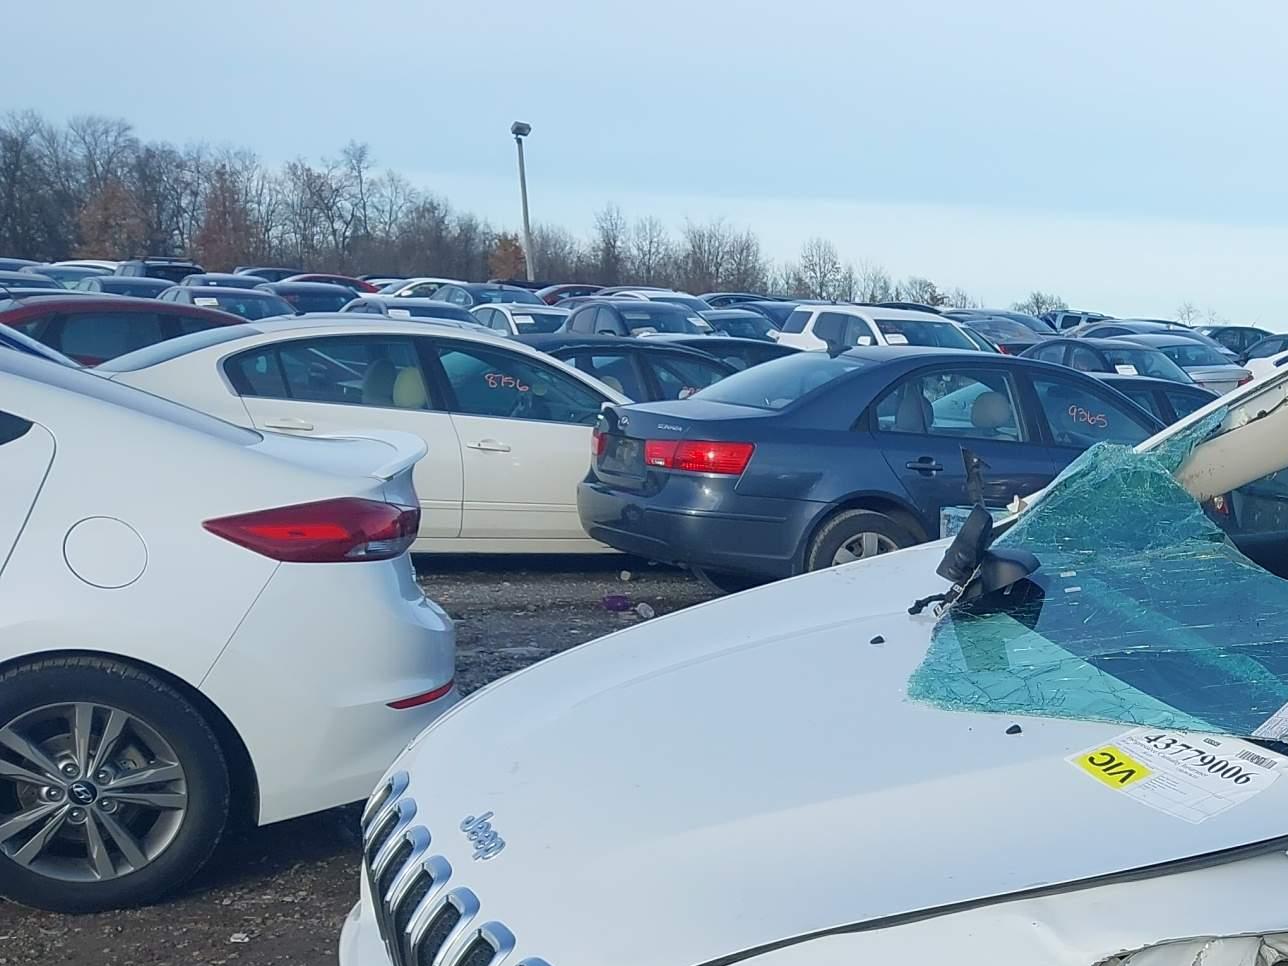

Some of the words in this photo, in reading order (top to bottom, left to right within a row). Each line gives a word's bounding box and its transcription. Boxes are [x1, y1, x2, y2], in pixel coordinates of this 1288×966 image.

[1068, 404, 1108, 428] 9365
[1088, 752, 1137, 784] VIC
[1143, 734, 1260, 785] 43779006
[459, 811, 506, 861] Jeep
